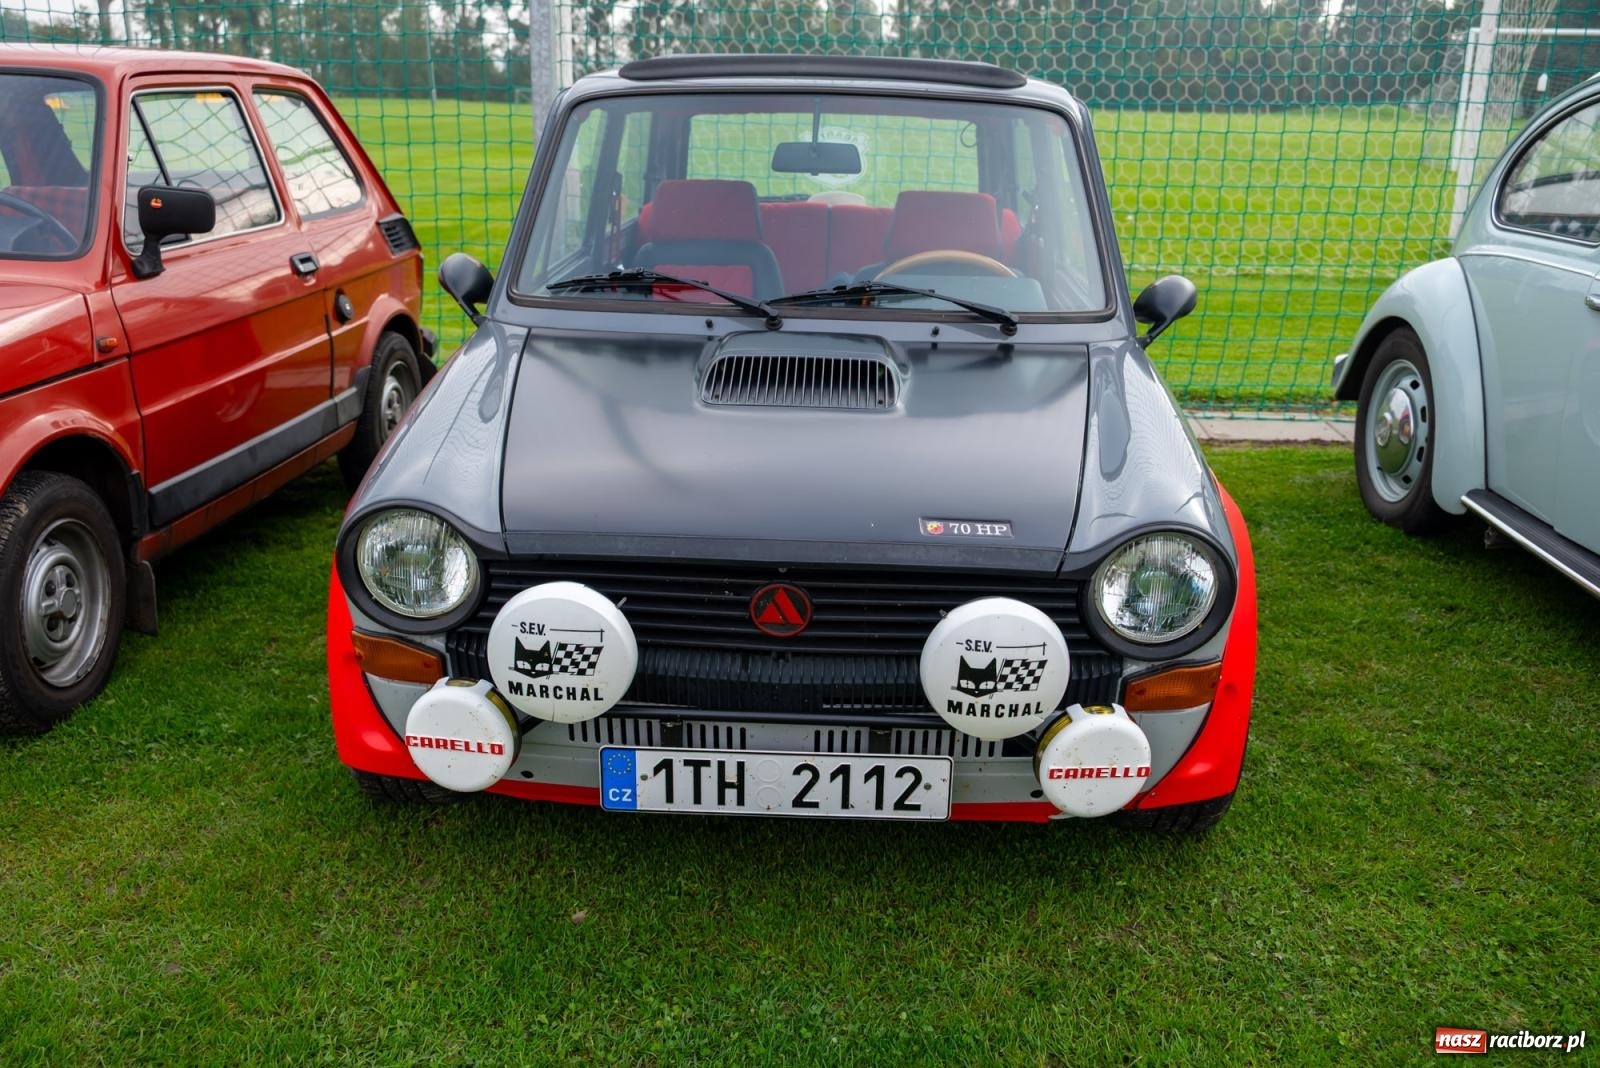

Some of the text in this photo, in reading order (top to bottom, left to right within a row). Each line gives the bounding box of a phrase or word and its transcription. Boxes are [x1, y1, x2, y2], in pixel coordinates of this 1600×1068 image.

[949, 523, 1007, 536] 70 HP
[519, 621, 546, 636] S.E.V.
[965, 639, 993, 653] S.E.V.
[508, 680, 604, 701] MARCHAL
[947, 699, 1043, 718] MARCHAL
[405, 735, 504, 755] CARELLO
[1048, 766, 1151, 779] CARELLO
[608, 758, 923, 811] CZ 1TH 2112
